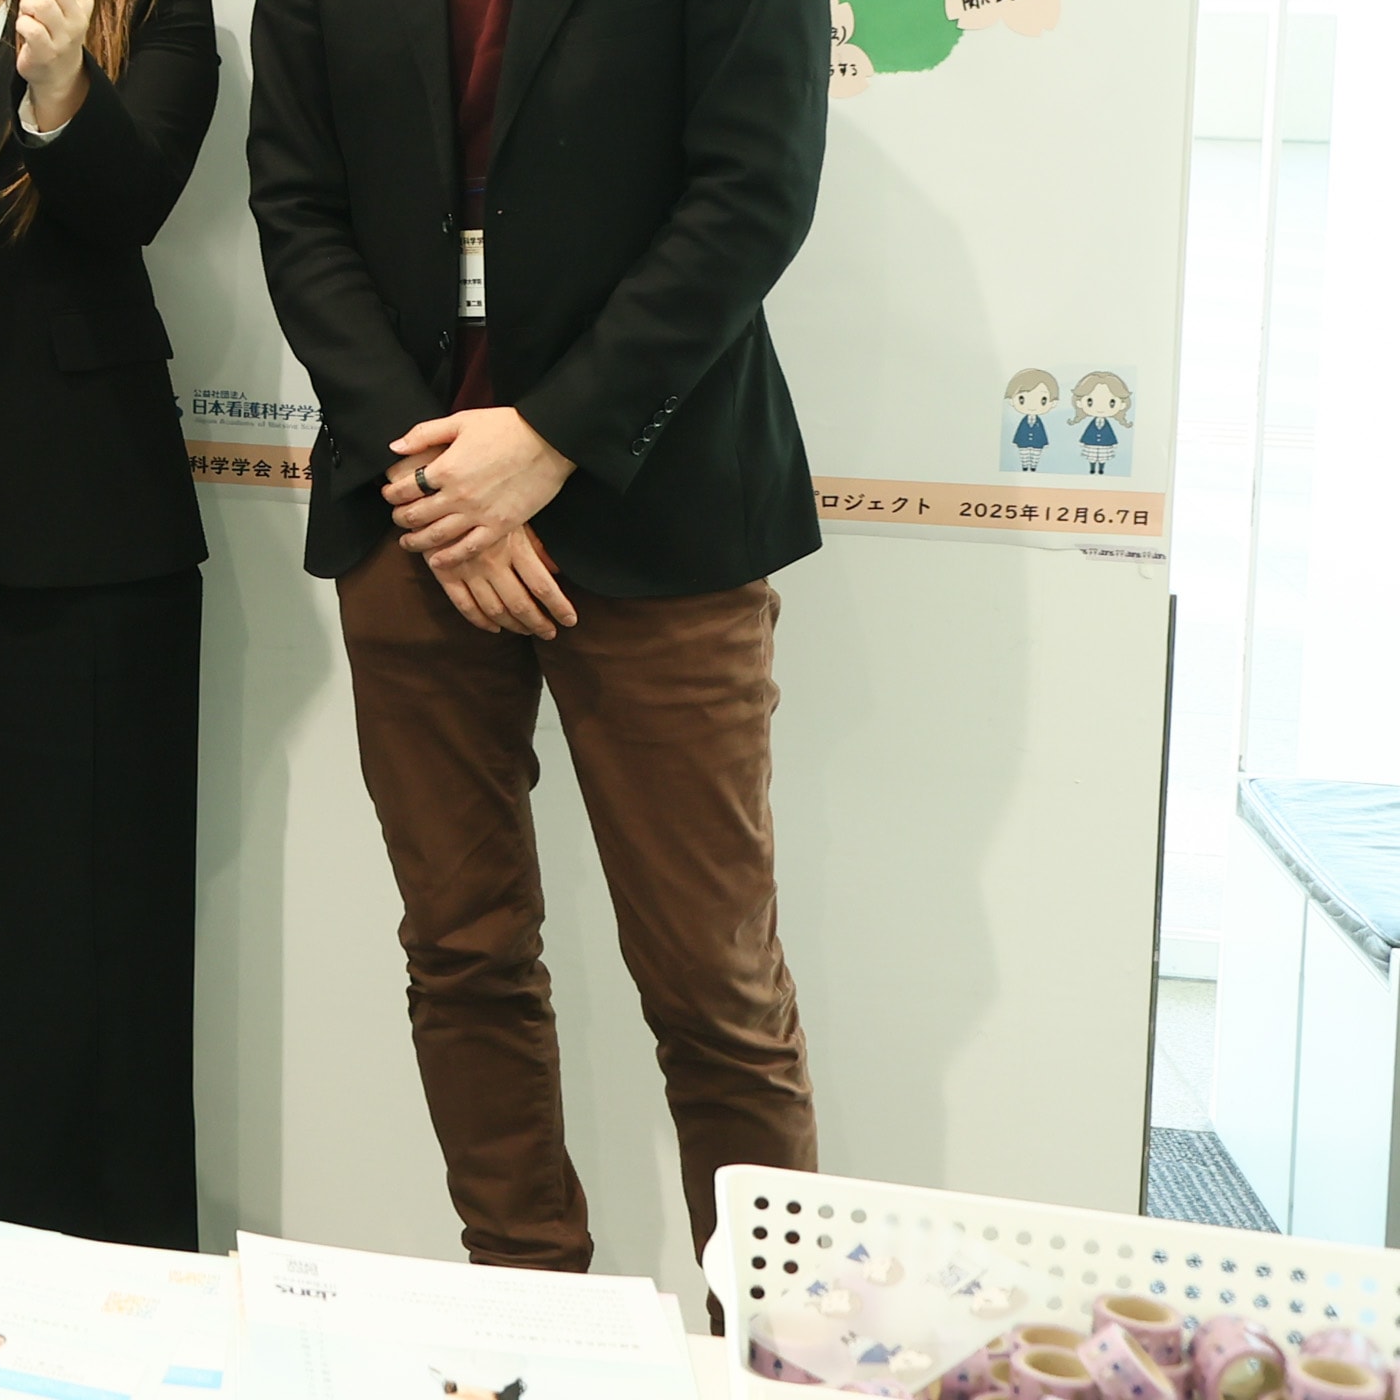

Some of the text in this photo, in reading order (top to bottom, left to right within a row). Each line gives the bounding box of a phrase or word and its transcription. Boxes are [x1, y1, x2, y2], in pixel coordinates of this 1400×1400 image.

[193, 389, 247, 400] 公益社団法人
[814, 489, 1150, 528] ロジェクト 2025年12月6.7日
